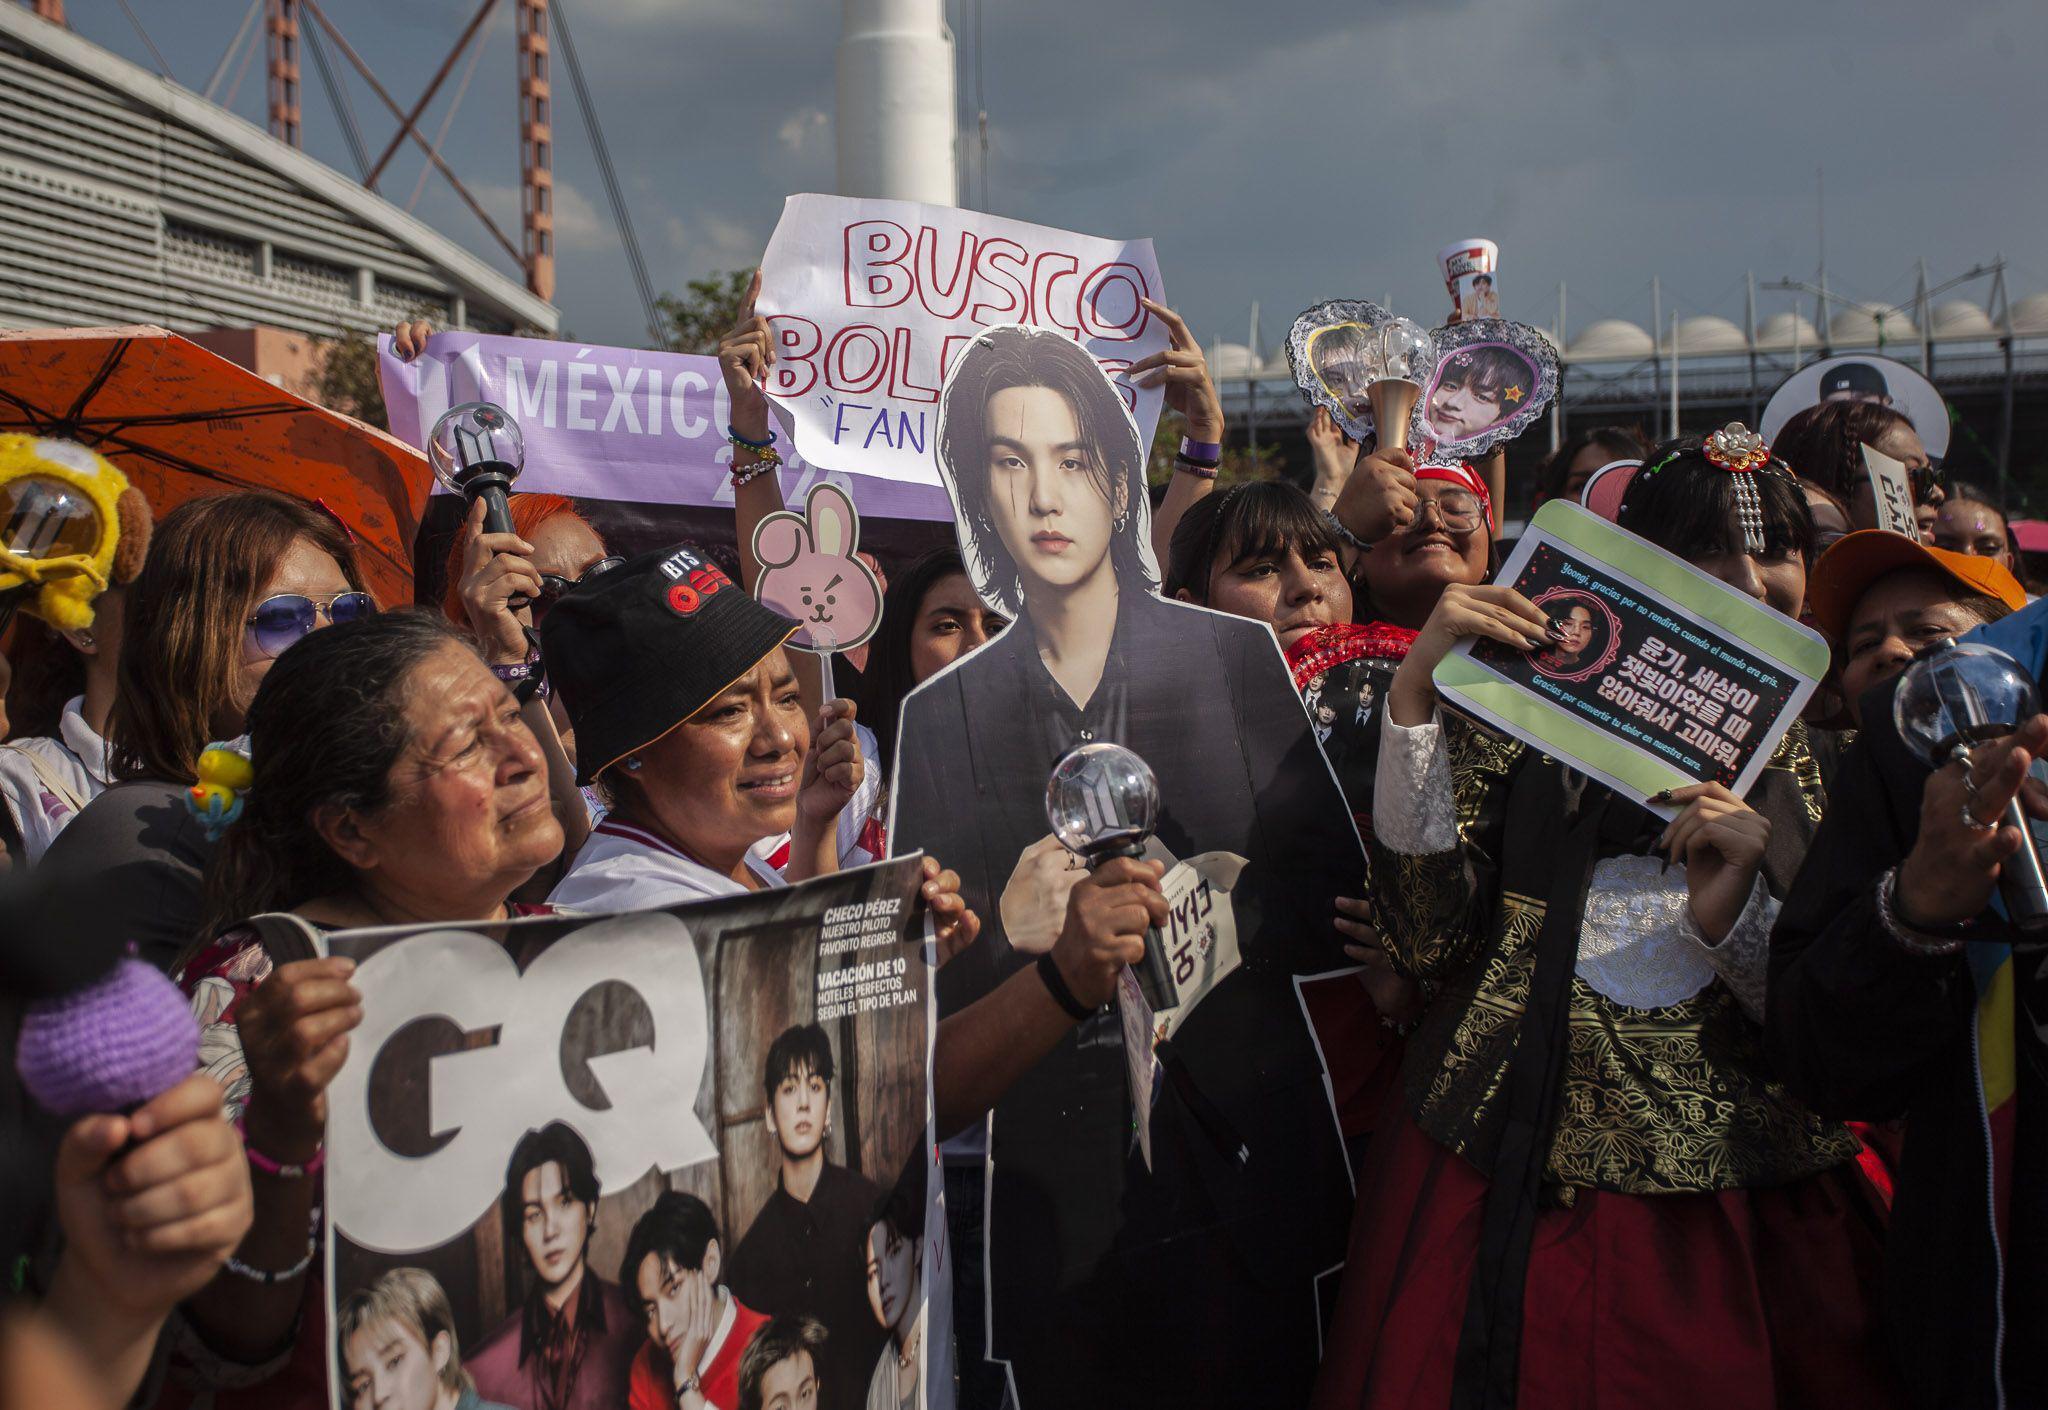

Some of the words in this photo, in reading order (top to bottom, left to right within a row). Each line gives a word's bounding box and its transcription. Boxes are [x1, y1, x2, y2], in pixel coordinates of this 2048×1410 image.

[844, 219, 1150, 341] BUSCO
[660, 549, 700, 579] BTS
[1560, 562, 1590, 585] Yoongi,
[1591, 580, 1621, 601] gracias
[1620, 596, 1637, 608] por
[1636, 604, 1648, 615] no
[1648, 611, 1681, 634] rendirte
[1680, 629, 1710, 650] cuando
[1710, 646, 1722, 656] el
[1719, 651, 1746, 670] mundo
[1746, 665, 1761, 678] era
[1759, 674, 1778, 689] gris.
[1617, 654, 1726, 728] 잿빛이었을
[1721, 713, 1753, 743] 때
[1638, 635, 1688, 679] 윤기,
[1688, 665, 1760, 716] 세상이
[1532, 674, 1562, 697] Gracias
[1560, 691, 1577, 704] por
[1576, 699, 1612, 723] convertir
[1611, 715, 1622, 728] tu
[1621, 721, 1642, 738] dolor
[1641, 732, 1653, 743] en
[1652, 738, 1683, 760] nuestra
[1682, 754, 1702, 772] cura.
[1596, 675, 1680, 733] 않아줘서
[1674, 718, 1742, 771] 고마워.
[821, 920, 861, 940] NUESTRO
[861, 916, 891, 933] PILOTO
[823, 902, 864, 925] CHECO
[864, 898, 901, 918] PÉREZ
[819, 937, 860, 957] FAVORITO
[860, 930, 897, 949] REGRESA
[817, 962, 874, 990] VACACIÓN
[876, 959, 891, 978] DE
[892, 957, 906, 975] 10
[818, 986, 854, 1006] HOTELES
[855, 976, 902, 997] PERFECTOS
[817, 1001, 846, 1021] SEGÚN
[847, 1002, 858, 1015] EL
[859, 996, 878, 1012] TIPO
[879, 994, 891, 1008] DE
[893, 989, 917, 1005] PLAN
[327, 912, 720, 1255] GQ
